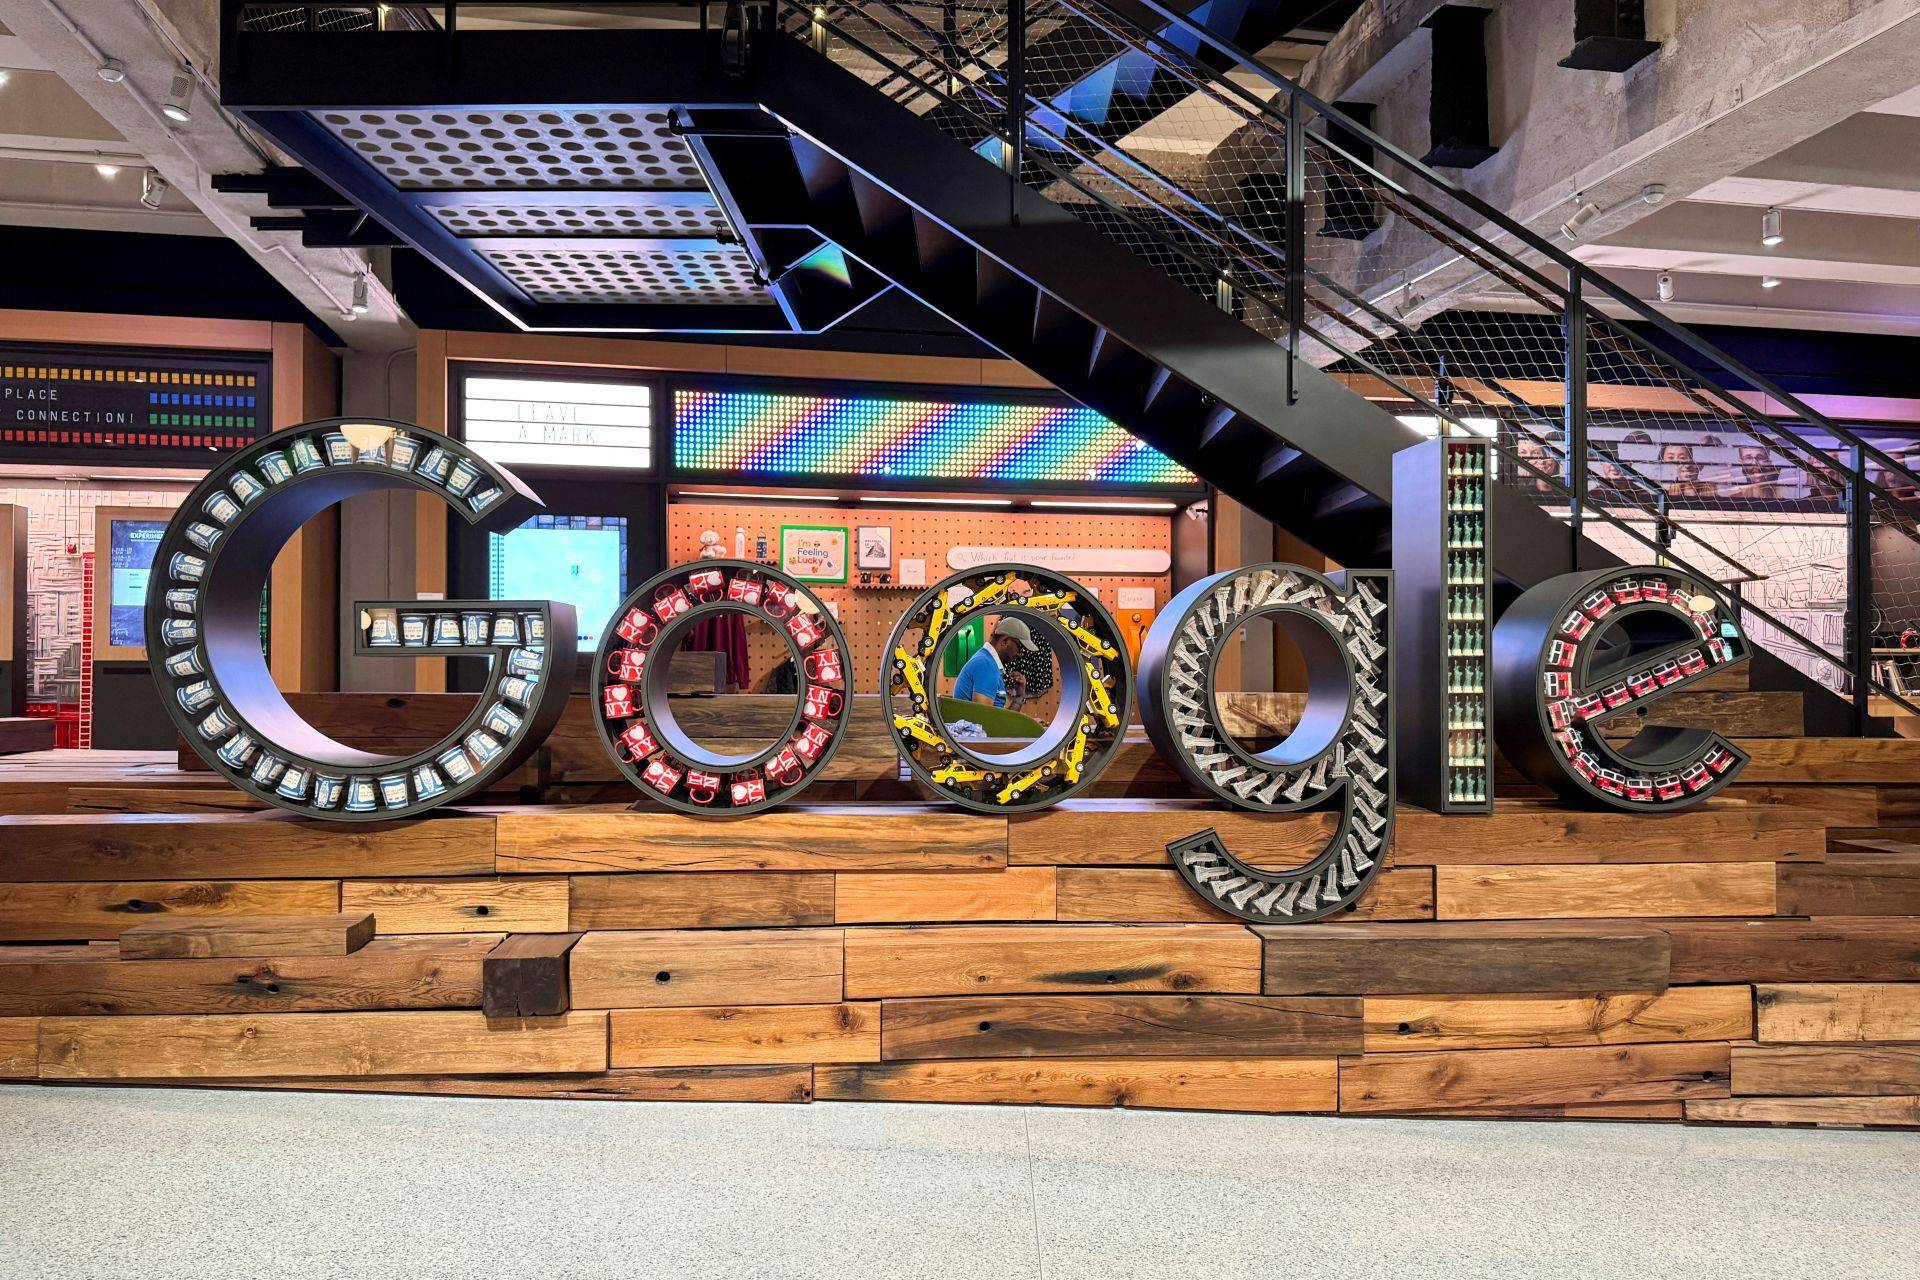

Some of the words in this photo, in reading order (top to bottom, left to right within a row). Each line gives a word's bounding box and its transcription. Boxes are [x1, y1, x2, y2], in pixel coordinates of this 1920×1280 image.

[5, 388, 58, 401] PLACE
[16, 410, 133, 424] CONNECTION!
[543, 426, 595, 444] MARK
[797, 547, 828, 558] Feeling
[797, 556, 823, 566] Lucky
[146, 416, 1752, 922] Google
[620, 665, 643, 679] NY
[806, 687, 830, 704] NY
[605, 701, 630, 716] NY
[803, 724, 829, 746] NY
[629, 736, 655, 759] NY
[655, 768, 678, 794] NY
